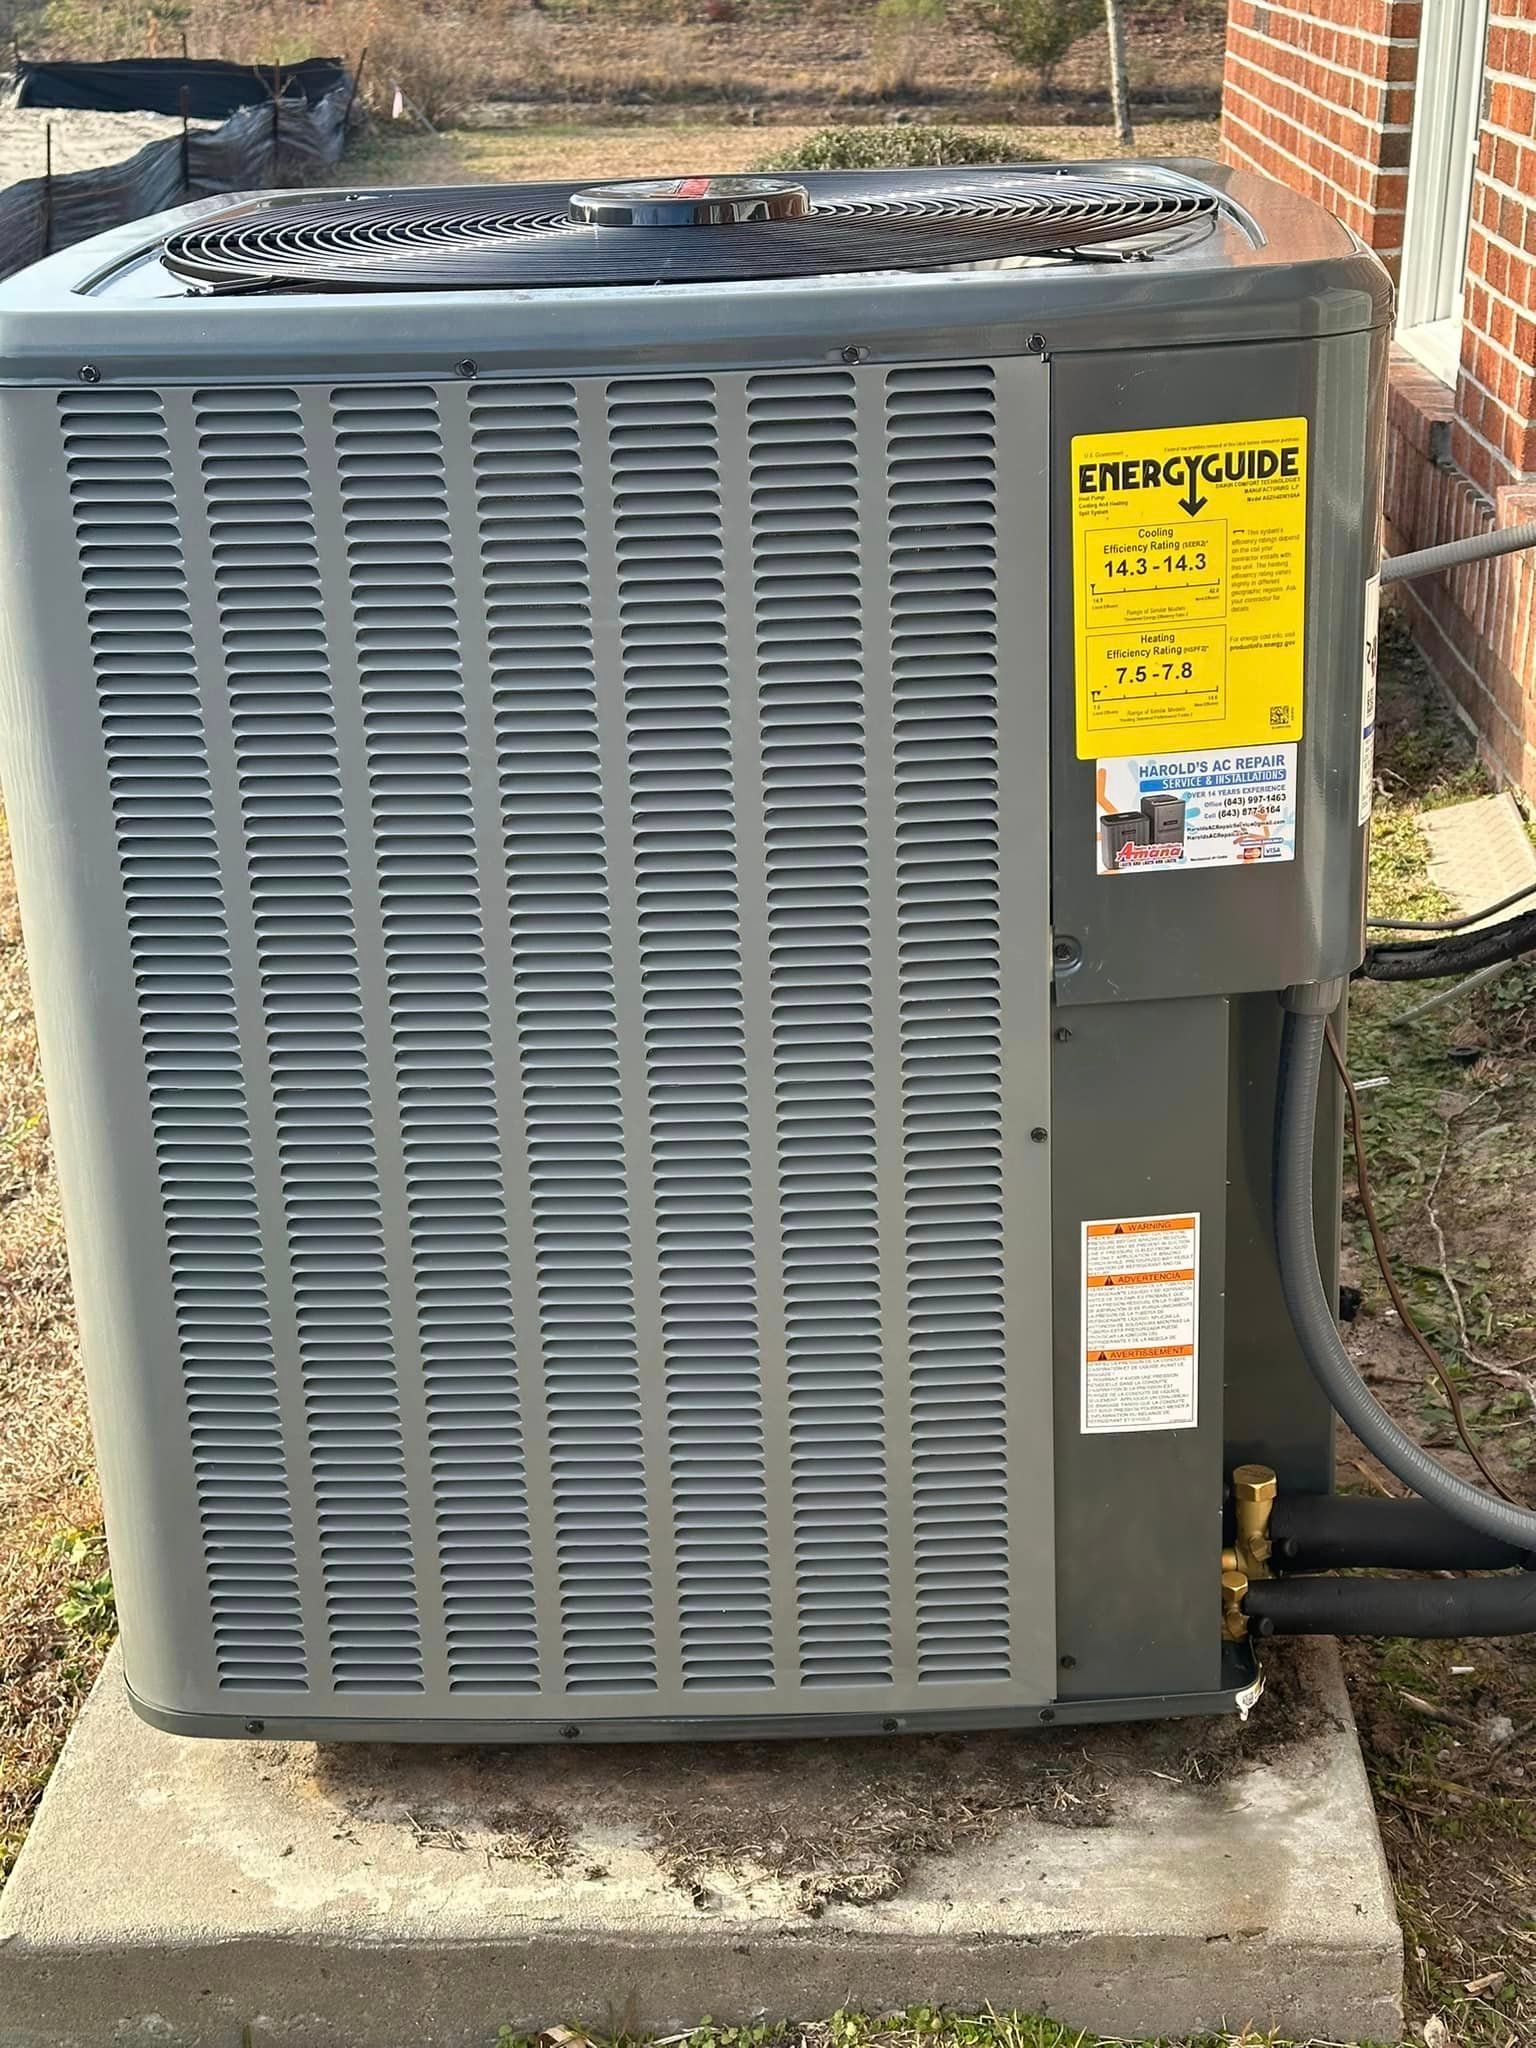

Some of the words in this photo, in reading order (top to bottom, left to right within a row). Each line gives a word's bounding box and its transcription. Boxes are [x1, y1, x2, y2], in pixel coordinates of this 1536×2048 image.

[1079, 447, 1299, 493] ENERGYGUIDE
[1138, 528, 1174, 538] Cooling
[1104, 544, 1148, 554] Efficiency
[1150, 541, 1180, 550] Rating
[1104, 558, 1147, 578] 14.3
[1164, 552, 1206, 573] 14.3
[1141, 634, 1175, 644] Heating
[1107, 649, 1151, 659] Efficiency
[1153, 645, 1182, 655] Rating
[1116, 666, 1147, 684] 7.5
[1162, 662, 1192, 680] 7.8
[1139, 761, 1208, 778] HAROLD'S
[1212, 759, 1231, 771] AC
[1236, 754, 1285, 770] REPAIR
[1162, 775, 1202, 790] SERVICE
[1205, 776, 1212, 785] &
[1215, 769, 1284, 785] INSTALLATIONS
[1242, 784, 1285, 794] EXPERIENCE
[1118, 842, 1181, 860] Amana
[1128, 1222, 1172, 1231] WARNING
[1118, 1272, 1181, 1283] ADVERTENCIA
[1110, 1347, 1184, 1358] AVERTISSEMENT
